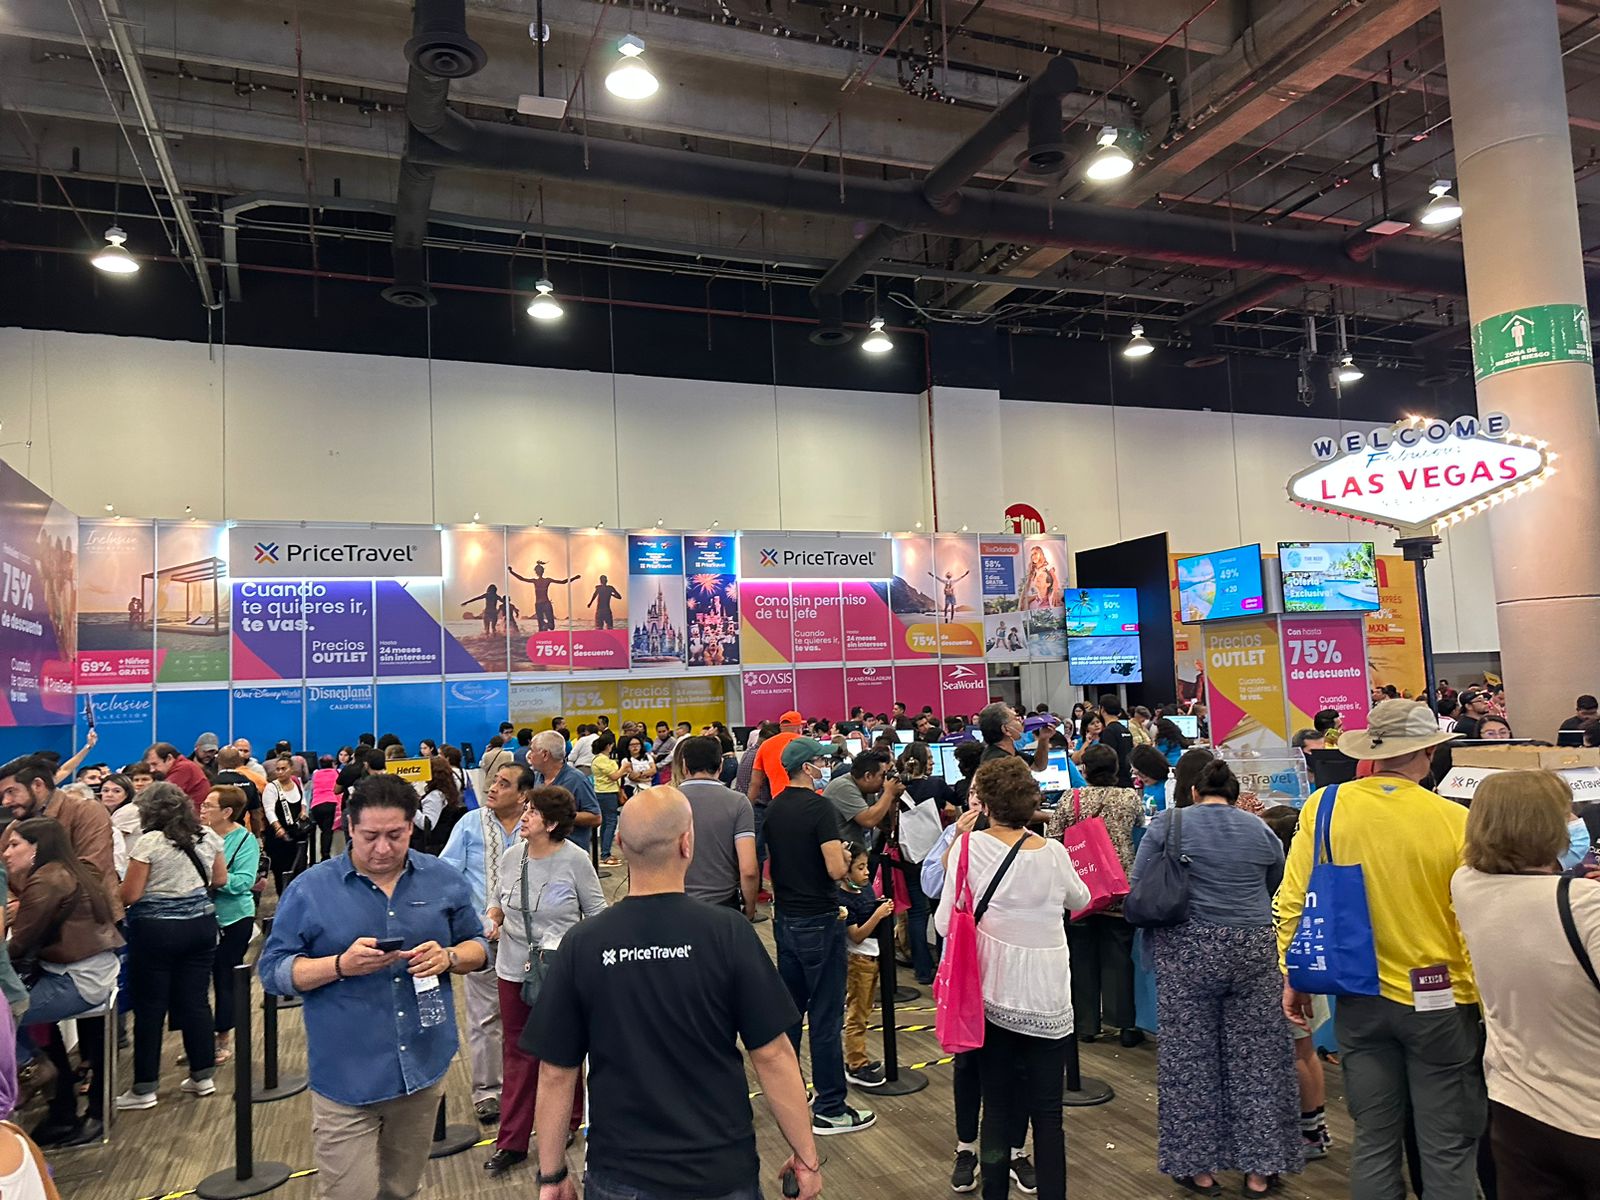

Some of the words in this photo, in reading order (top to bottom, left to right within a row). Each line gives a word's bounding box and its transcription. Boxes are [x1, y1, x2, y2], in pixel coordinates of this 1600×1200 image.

[1495, 356, 1521, 366] MENOR
[1521, 351, 1550, 360] RIESGO
[1504, 349, 1526, 358] ZONA
[1314, 416, 1503, 457] WELCOME
[1321, 473, 1384, 500] LAS
[1398, 457, 1517, 491] VEGAS
[287, 544, 413, 562] PriceTravel
[784, 550, 874, 566] PriceTravel
[2, 562, 34, 611] 75%
[241, 582, 326, 597] Cuando
[755, 596, 780, 606] Con
[794, 595, 811, 606] sin
[814, 594, 867, 609] permiso
[242, 600, 263, 614] te
[267, 599, 345, 618] quieres
[350, 599, 367, 616] ir,
[756, 608, 773, 619] de
[776, 608, 789, 619] tu
[794, 607, 817, 622] jefe
[242, 617, 267, 632] te
[269, 619, 315, 632] vas.
[1368, 624, 1389, 633] MXN
[1287, 628, 1301, 636] Con
[312, 640, 365, 651] Precios
[804, 637, 832, 647] quieres
[912, 636, 937, 646] 75%
[1210, 632, 1262, 650] Precios
[536, 645, 567, 657] 75%
[1288, 639, 1342, 665] 75%
[312, 652, 367, 664] OUTLET
[380, 654, 394, 662] sin
[1211, 649, 1265, 668] OUTLET
[81, 662, 112, 672] 69%
[119, 668, 150, 676] GRATIS
[1291, 669, 1304, 679] de
[1305, 667, 1361, 679] descuento
[759, 673, 792, 684] OASIS
[1238, 677, 1265, 685] Cuando
[622, 685, 670, 697] Precios
[943, 680, 984, 690] SeaWorld
[253, 687, 281, 699] Disney
[308, 686, 372, 701] Disneyland
[1319, 695, 1348, 703] Cuando
[565, 692, 605, 708] 75%
[621, 698, 671, 710] OUTLET
[396, 766, 421, 774] Hertz
[619, 945, 689, 962] PriceTravel
